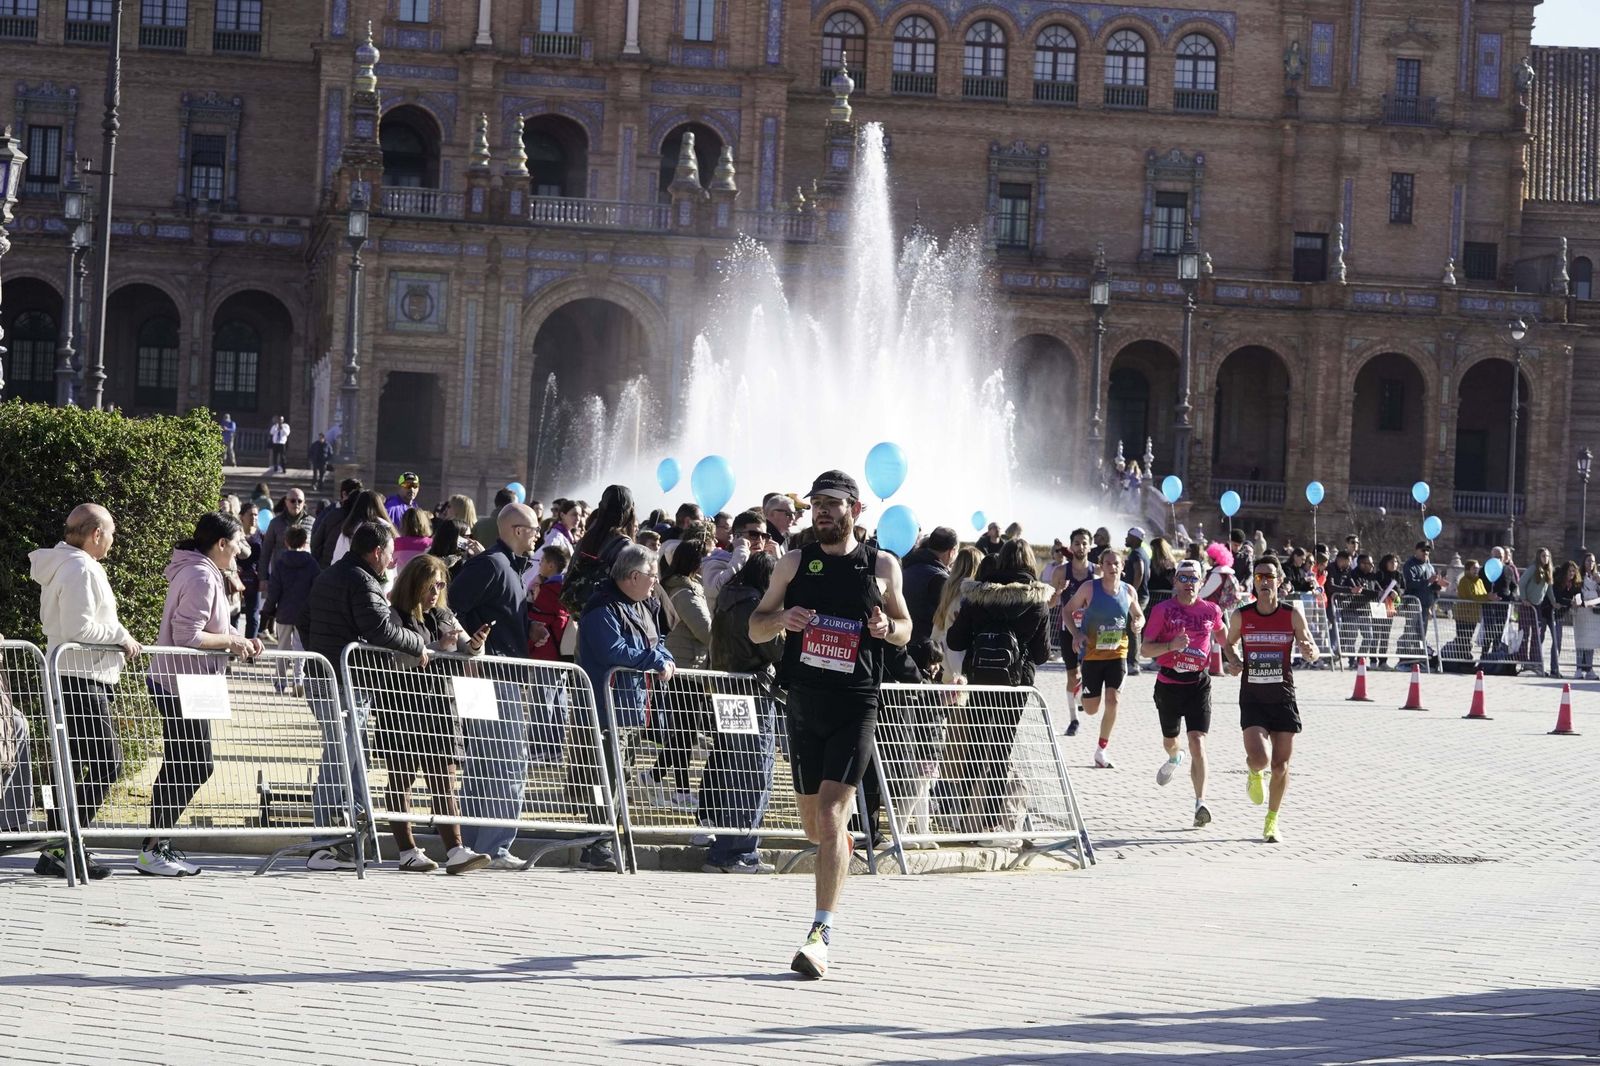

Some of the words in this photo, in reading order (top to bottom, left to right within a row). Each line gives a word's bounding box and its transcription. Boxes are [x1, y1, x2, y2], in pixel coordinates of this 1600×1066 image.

[823, 618, 855, 630] ZURICH
[822, 633, 839, 643] 1318
[806, 641, 851, 660] MATHIEU
[1248, 668, 1283, 676] BEJARANO
[723, 700, 745, 716] AMS
